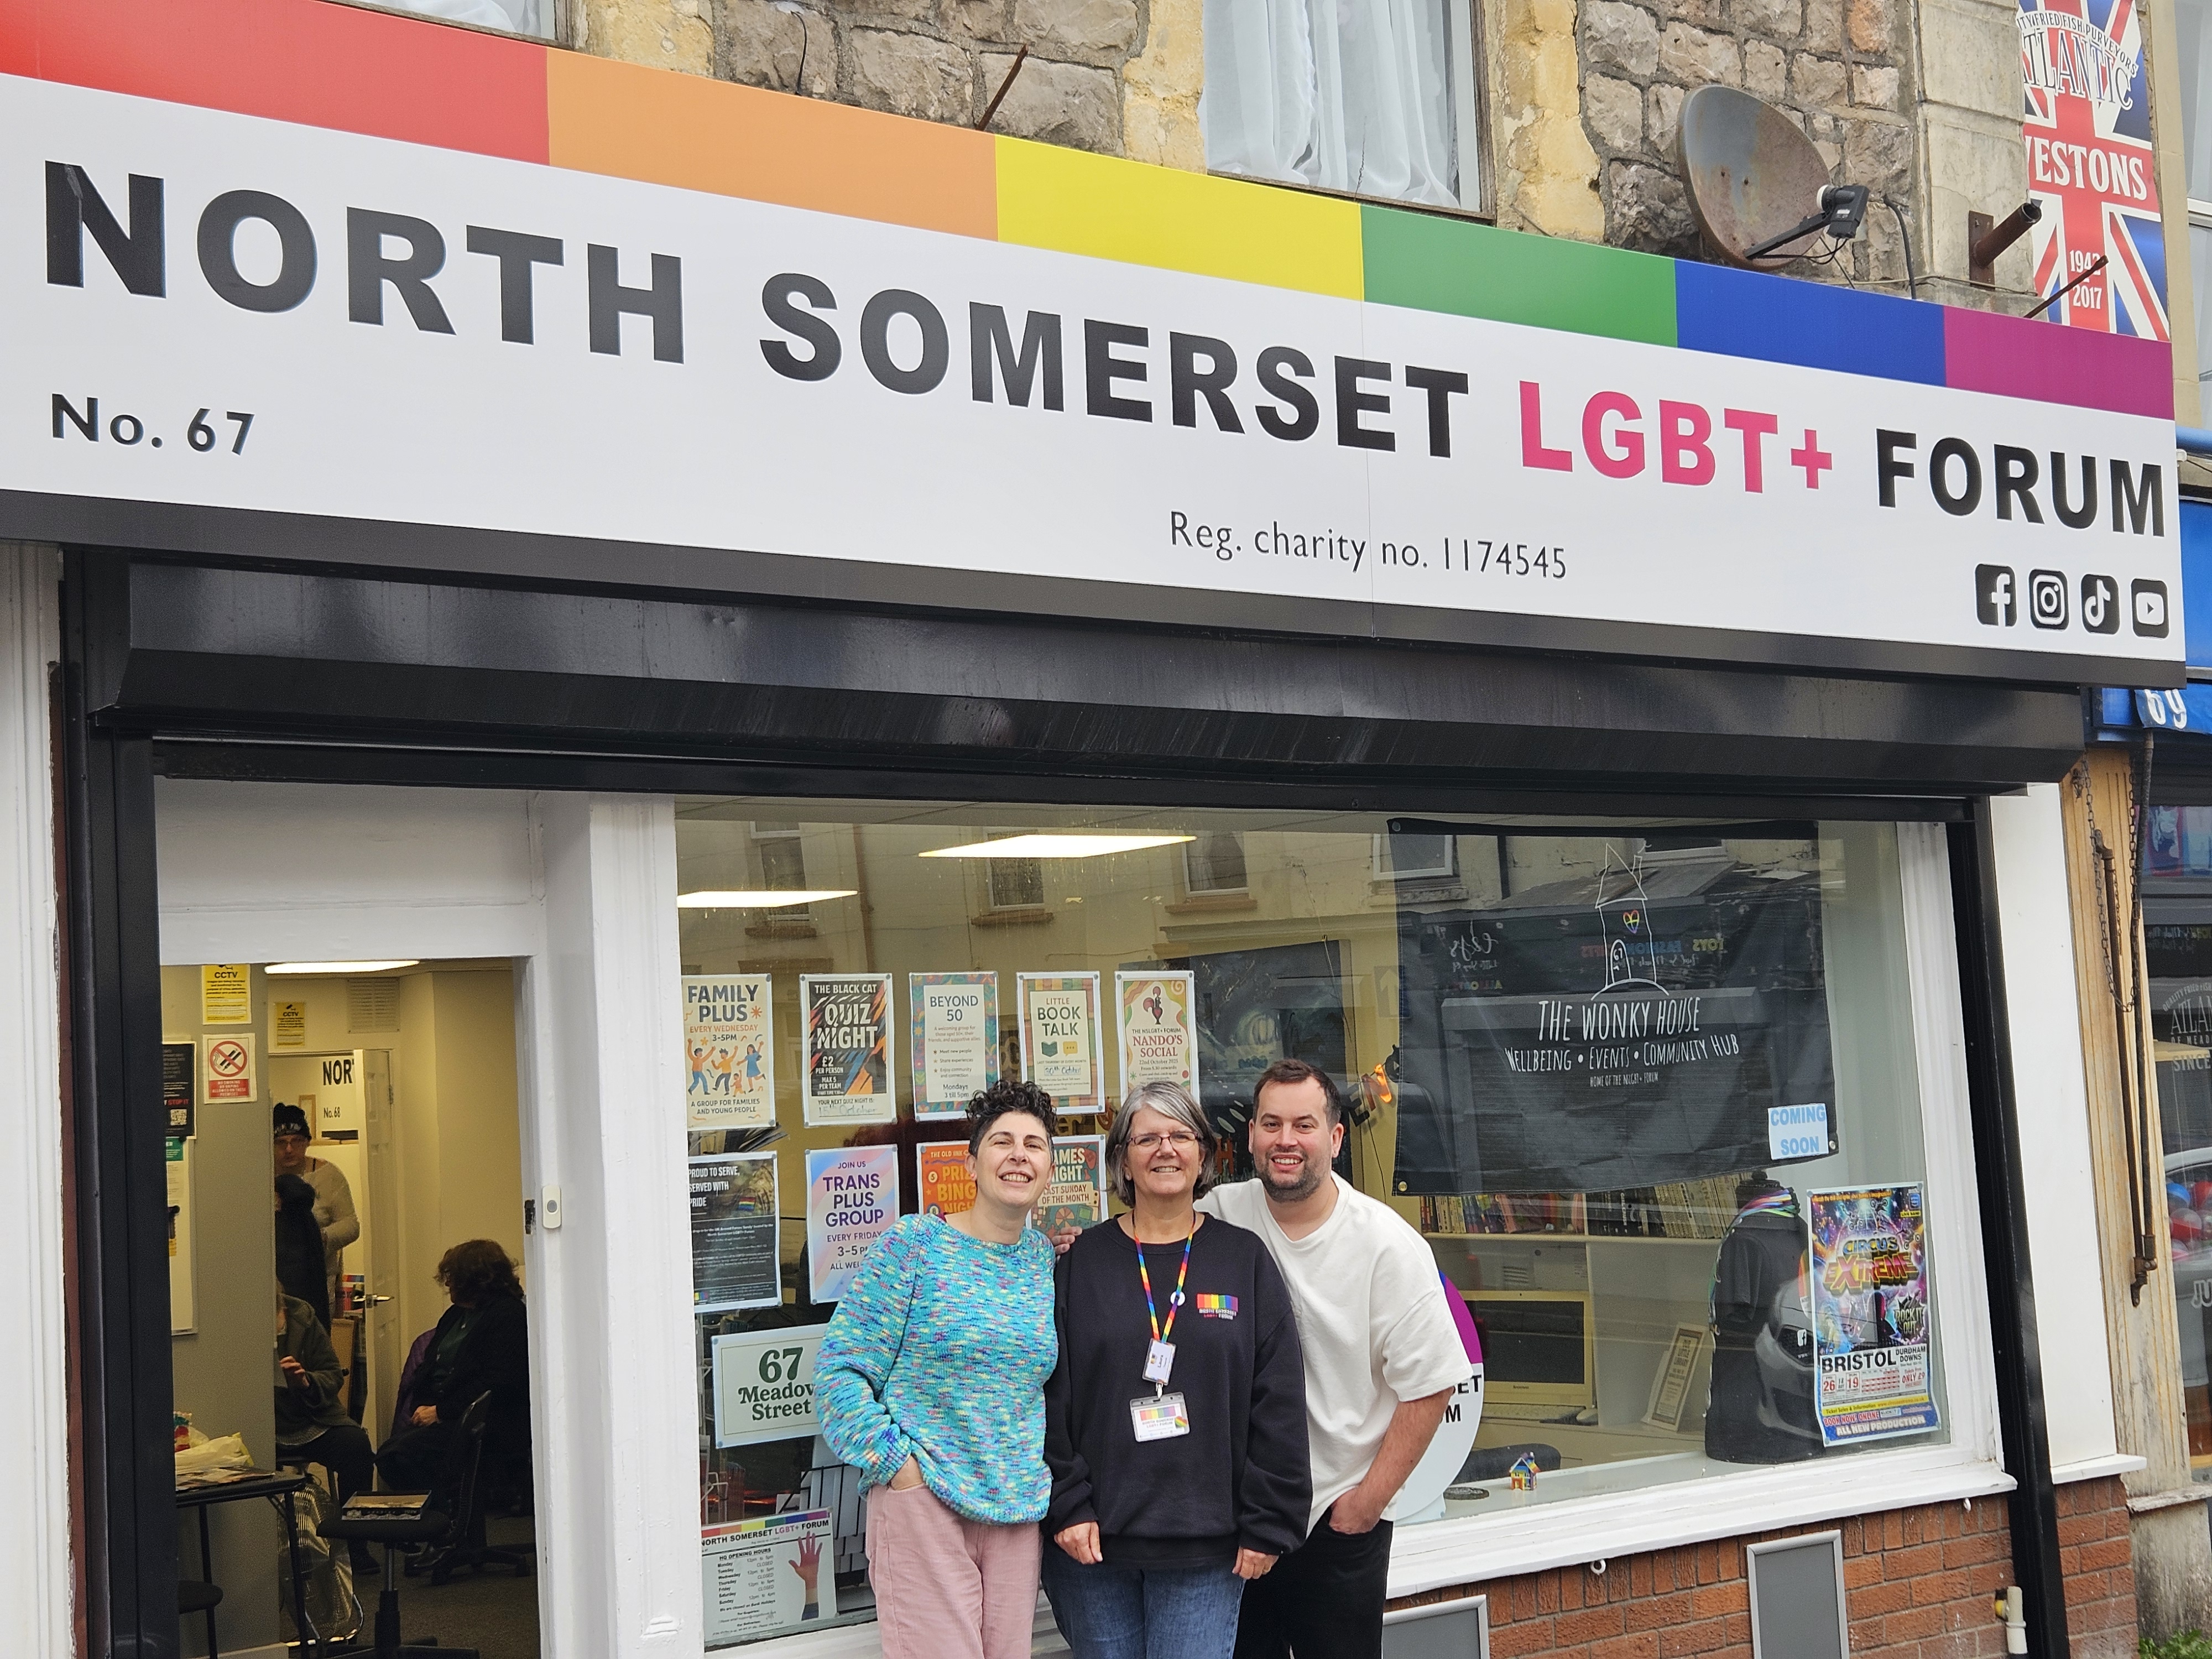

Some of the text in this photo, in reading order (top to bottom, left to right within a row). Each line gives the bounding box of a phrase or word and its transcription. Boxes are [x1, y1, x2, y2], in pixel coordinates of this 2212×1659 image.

[2034, 13, 2060, 26] FRIED
[2063, 15, 2082, 33] FISH
[2086, 24, 2137, 75] PURVEYORS
[2023, 28, 2133, 110] TLANTIC
[2070, 250, 2100, 275] 1942
[2073, 285, 2102, 309] 2017
[44, 160, 2166, 538] NORTH SOMERSET LGBT+ FORUM
[51, 393, 255, 457] No. 67
[1170, 510, 1567, 580] Reg. charity no. 1174545
[1613, 948, 1623, 961] 67
[688, 984, 758, 1003] FAMILY
[815, 984, 877, 993] THE BLACK CAT
[930, 995, 978, 1007] BEYOND
[2162, 989, 2184, 1012] QUALITY
[2184, 983, 2199, 995] FRIED
[699, 1004, 748, 1022] PLUS
[825, 1003, 871, 1027] QUIZ
[947, 1009, 963, 1021] 50
[1037, 1006, 1081, 1020] BOOK
[1538, 997, 1700, 1041] THE WONKY HOUSE
[817, 1026, 878, 1048] NIGHT
[1042, 1022, 1079, 1036] TALK
[1133, 1035, 1182, 1046] NANDO'S
[1140, 1047, 1178, 1057] SOCIAL
[1505, 1034, 1739, 1072] WELLBEING EVENTS COMMUNITY HUB
[822, 1056, 833, 1067] £2
[2174, 1053, 2211, 1071] SINCE
[323, 1058, 354, 1086] NOR
[1590, 1076, 1604, 1087] HOME
[1605, 1075, 1611, 1086] OF
[1644, 1072, 1658, 1083] FORUM
[324, 1107, 333, 1118] No.
[1771, 1105, 1825, 1126] COMING
[1780, 1136, 1819, 1155] SOON
[709, 1167, 717, 1176] TO
[718, 1166, 740, 1176] SERVE,
[713, 1181, 729, 1191] WITH
[823, 1173, 880, 1192] TRANS
[1061, 1185, 1086, 1193] SUNDAY
[834, 1192, 874, 1209] PLUS
[1066, 1194, 1089, 1202] MONTH
[826, 1209, 884, 1227] GROUP
[827, 1231, 882, 1242] EVERY FRIDAY
[838, 1245, 858, 1256] 3-5
[1843, 1236, 1899, 1255] CIRCUS
[1895, 1307, 1923, 1324] ROCK IT
[1903, 1321, 1917, 1334] OUT
[1896, 1346, 1926, 1355] DURDHAM
[1900, 1354, 1922, 1362] DOWNS
[759, 1347, 804, 1383] 67
[1822, 1349, 1896, 1374] BRISTOL
[1823, 1380, 1835, 1391] 26
[1848, 1377, 1859, 1389] 19
[1902, 1374, 1916, 1383] ONLY
[752, 1399, 812, 1421] Street
[1824, 1417, 1840, 1426] BOOK
[1841, 1415, 1857, 1423] NOW!
[1859, 1411, 1880, 1420] ONLINE
[1837, 1415, 1926, 1436] ALL NEW PRODUCTION
[730, 1530, 773, 1542] SOMERSET
[775, 1525, 799, 1535] LGBT+
[802, 1520, 829, 1530] FORUM
